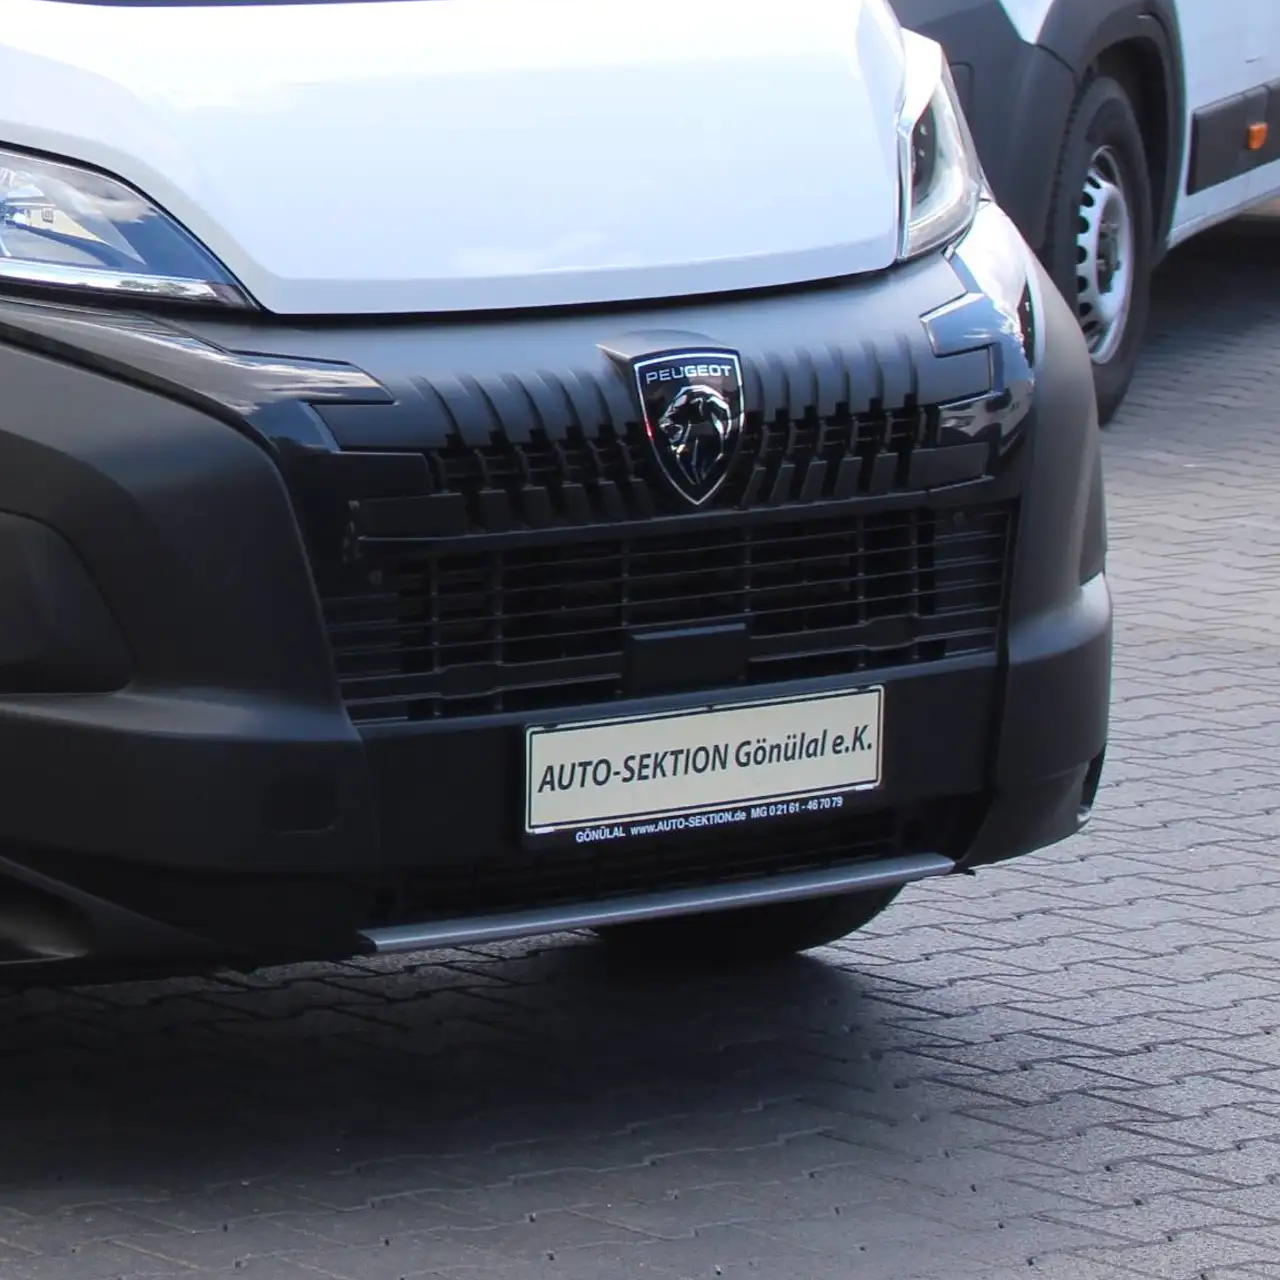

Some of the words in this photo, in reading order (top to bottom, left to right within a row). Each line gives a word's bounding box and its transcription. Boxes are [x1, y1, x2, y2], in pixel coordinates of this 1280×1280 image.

[645, 364, 732, 385] PEUGEOT
[537, 743, 730, 794] AUTO-SEKTION
[734, 728, 828, 768] Gönülal
[831, 724, 873, 755] e.K.
[575, 825, 626, 843] GÖNÜLAL
[630, 811, 746, 836] www.AUTO-SEKTION.de
